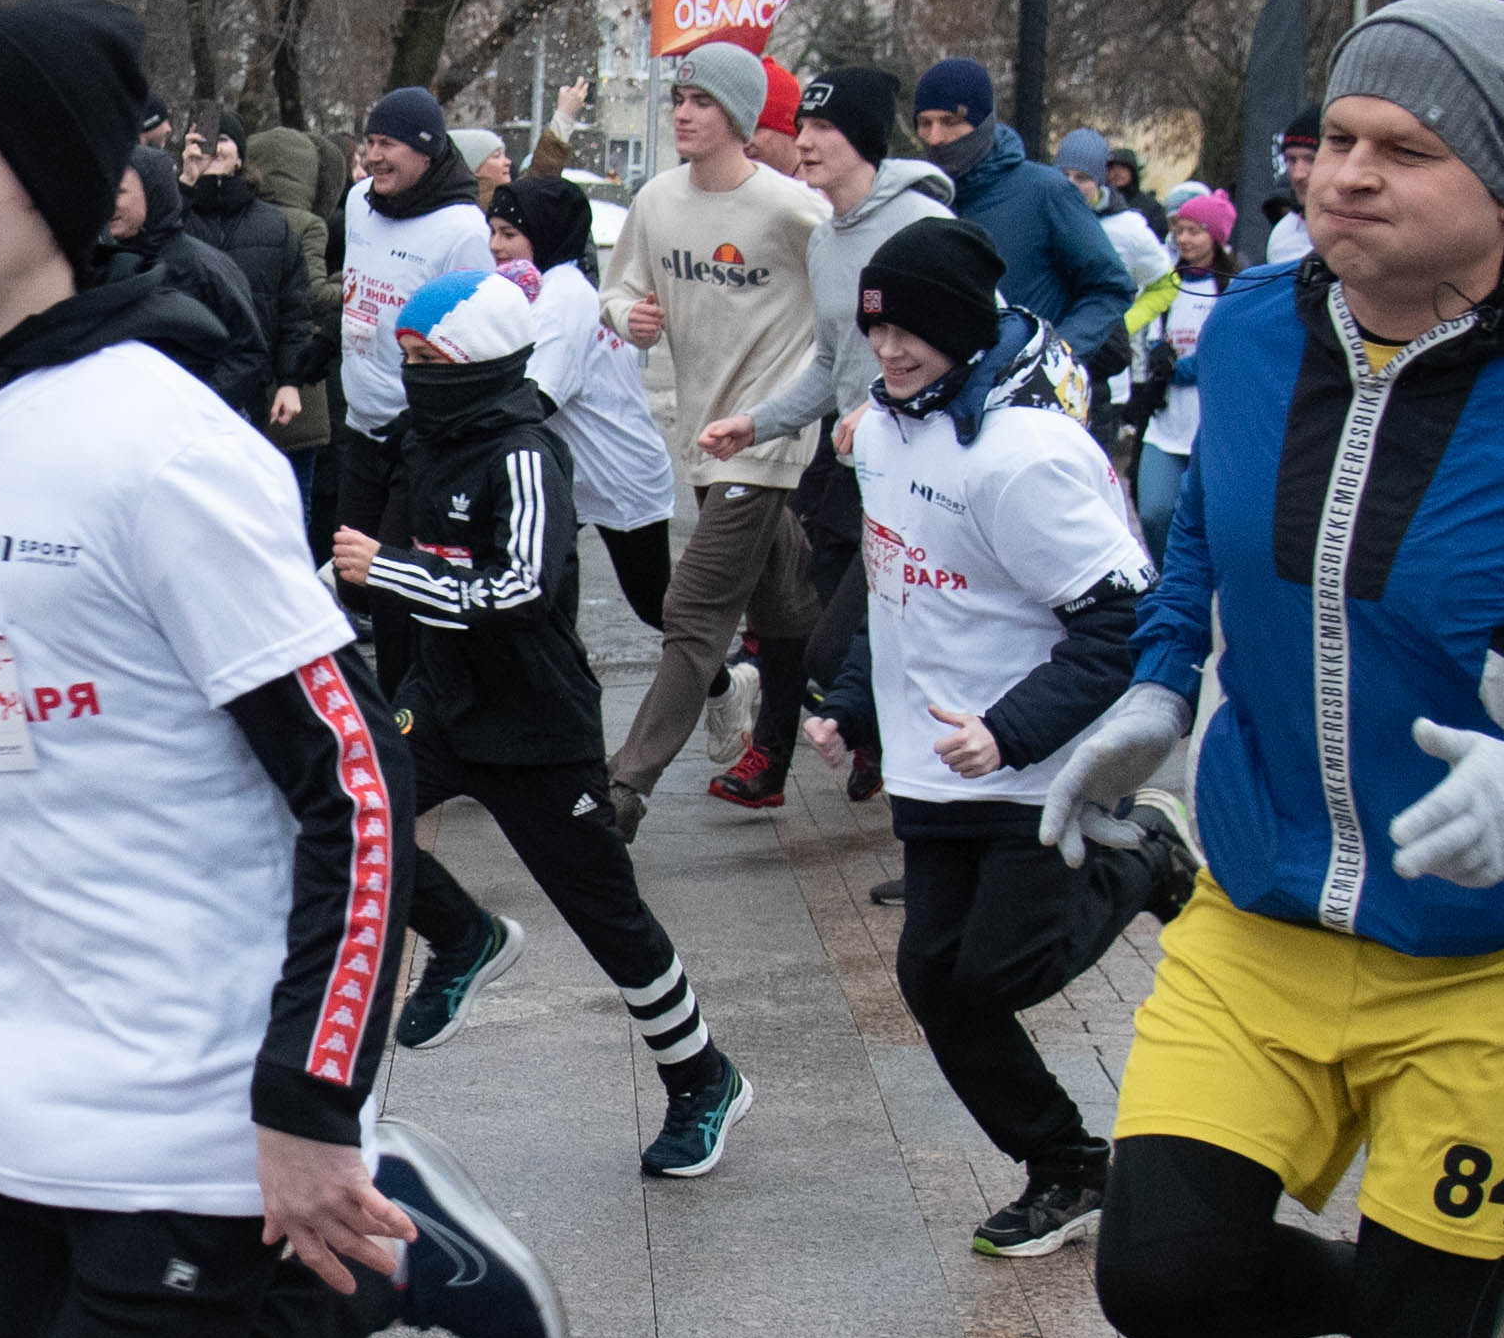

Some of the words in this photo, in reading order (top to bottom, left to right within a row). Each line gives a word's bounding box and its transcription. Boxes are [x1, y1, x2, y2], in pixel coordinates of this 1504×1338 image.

[661, 249, 770, 287] ellesse
[935, 492, 967, 512] SPORT
[18, 539, 84, 559] SPORT
